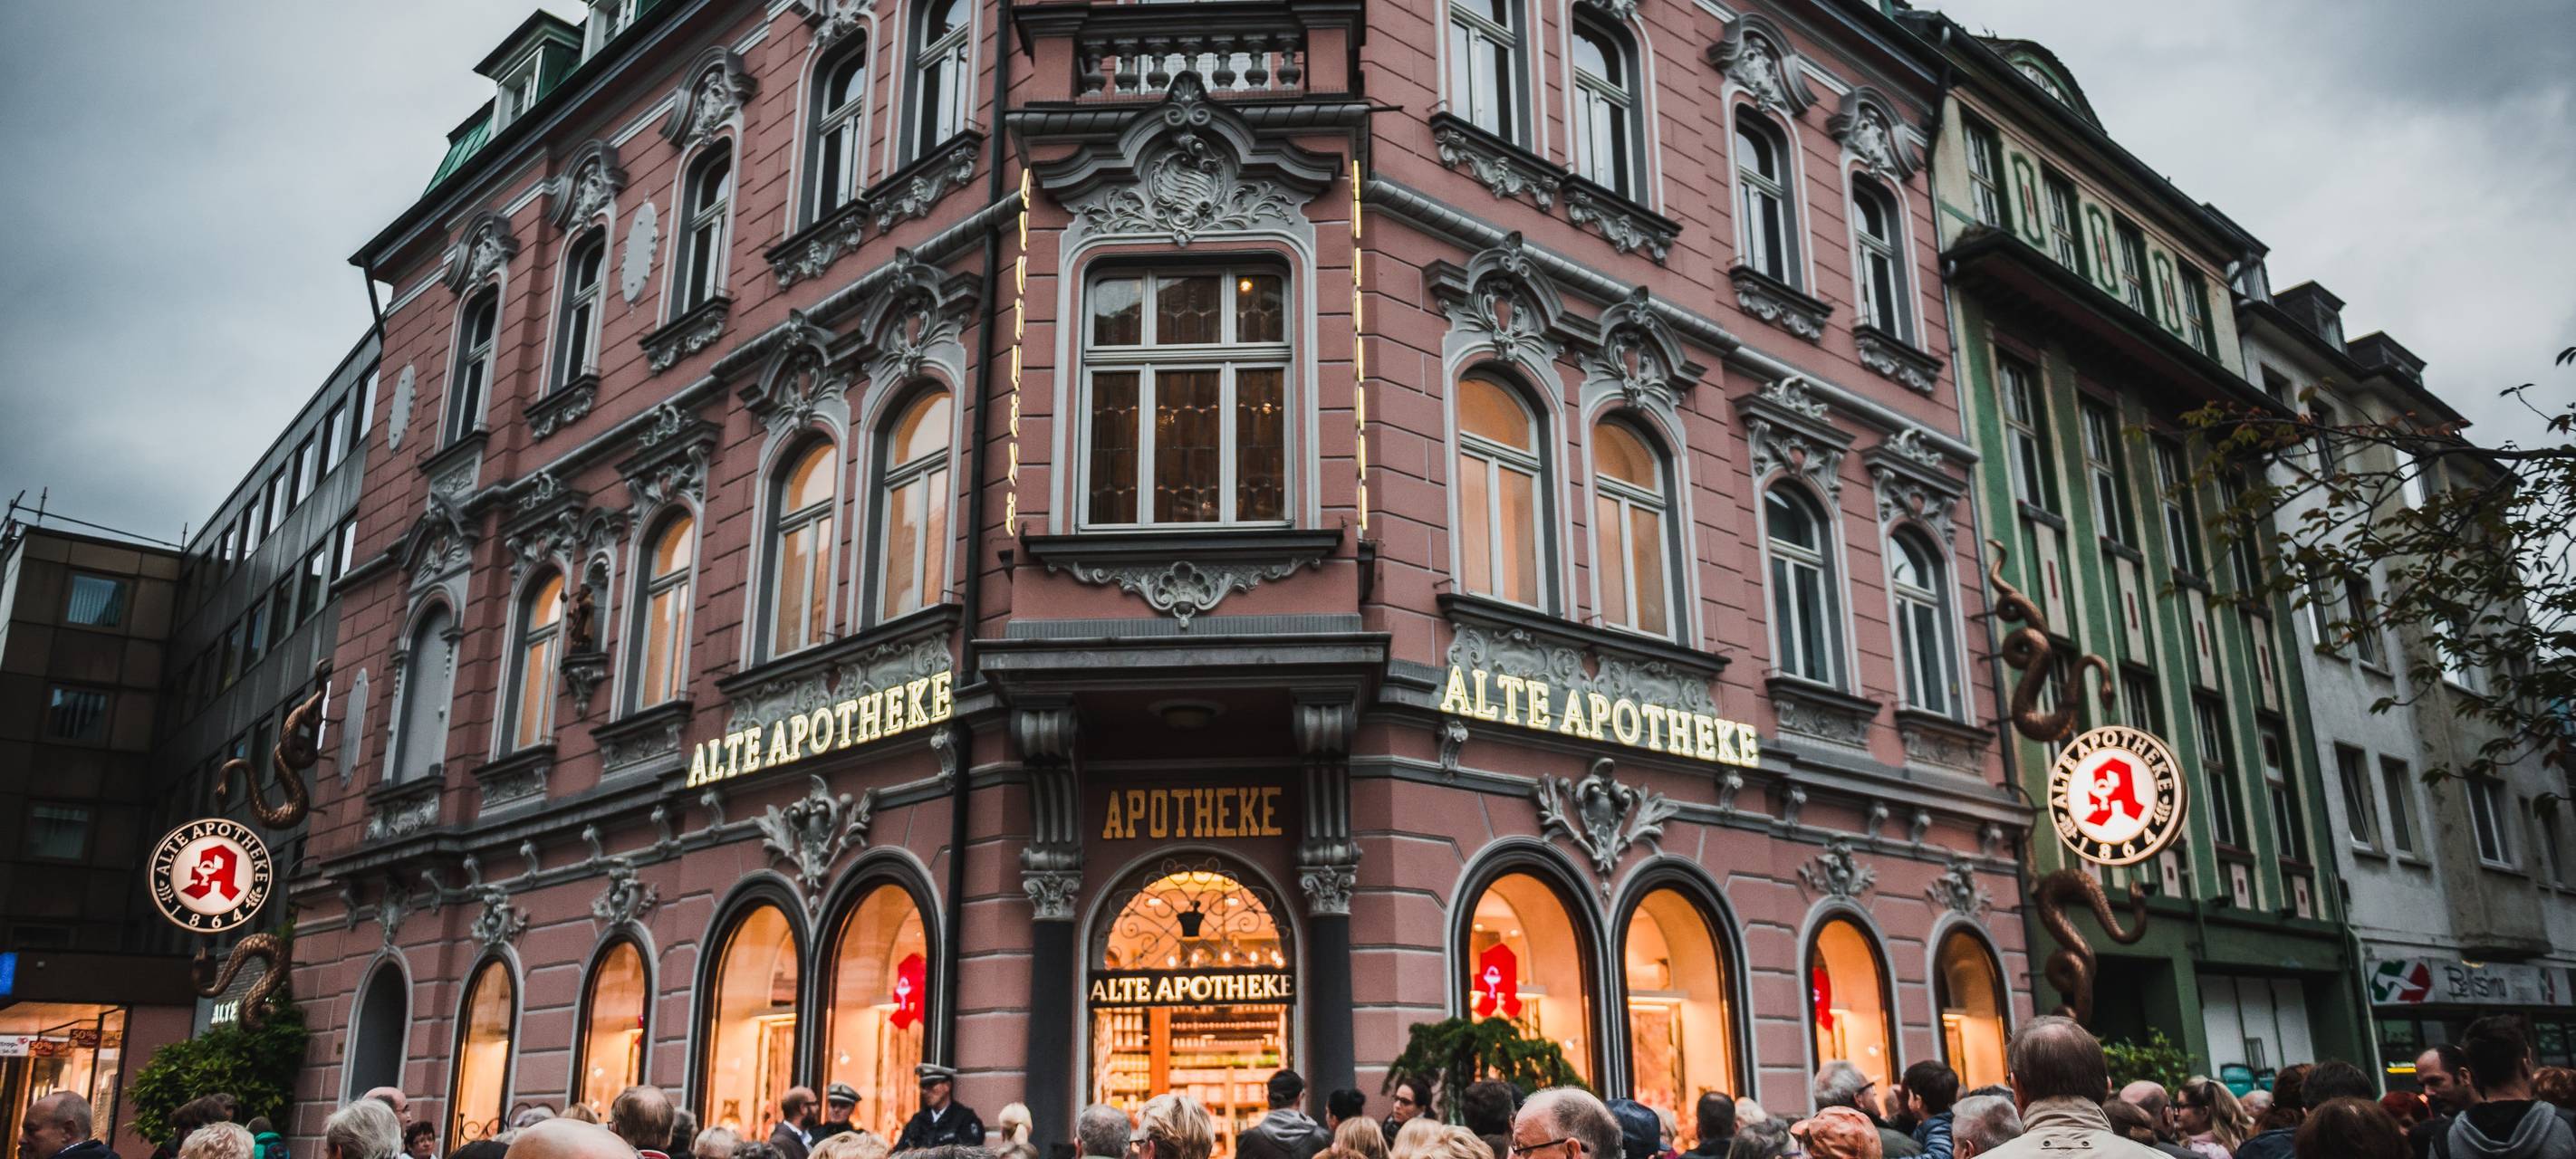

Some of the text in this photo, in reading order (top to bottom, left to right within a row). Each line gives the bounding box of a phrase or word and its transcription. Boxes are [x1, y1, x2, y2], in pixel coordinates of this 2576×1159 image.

[685, 669, 952, 789] ALTE APOTHEKE
[1439, 665, 1761, 769] ALTE APOTHEKE
[2052, 729, 2173, 809] ALTE APOTHEKE
[1101, 786, 1283, 839] APOTHEKE
[156, 821, 269, 883] ALTE APOTHEKE
[2079, 828, 2158, 861] 1864
[170, 905, 245, 930] 1864
[1090, 973, 1294, 1003] ALTE APOTHEKE
[210, 999, 240, 1025] ALTE
[30, 1041, 53, 1050] 50%
